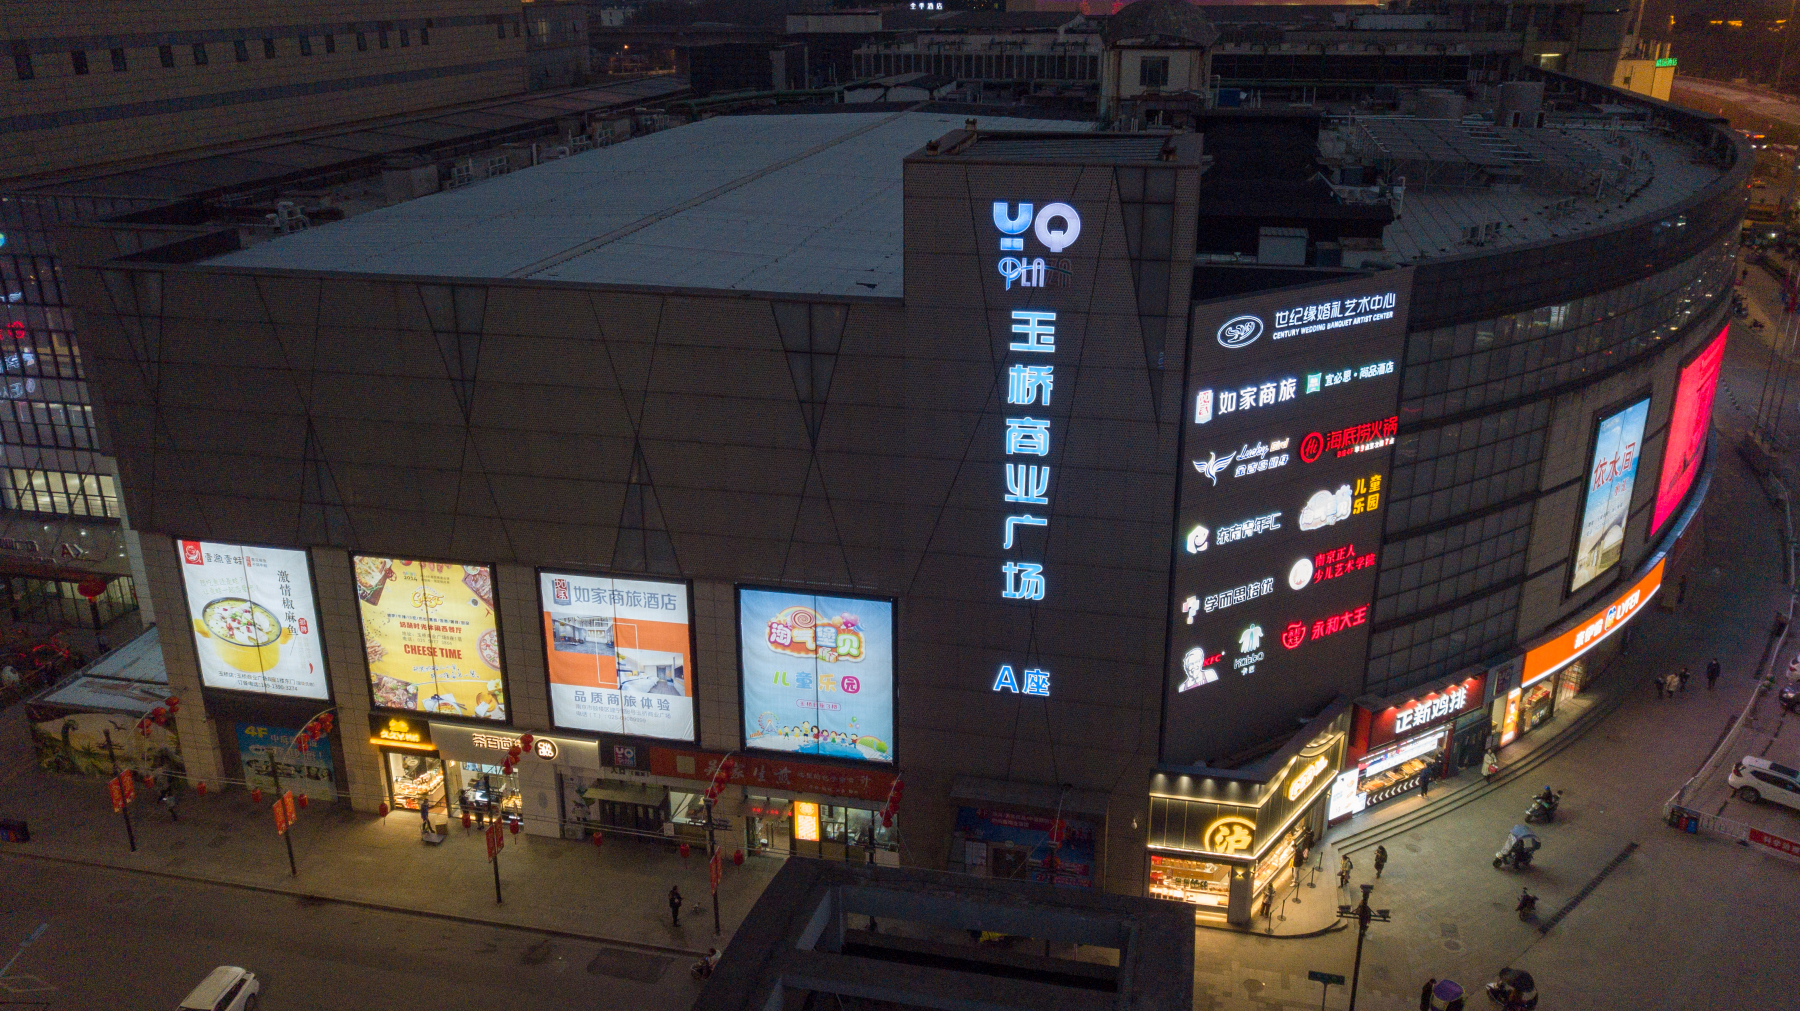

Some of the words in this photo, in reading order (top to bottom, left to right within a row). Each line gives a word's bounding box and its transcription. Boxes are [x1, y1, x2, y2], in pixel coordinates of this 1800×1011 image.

[1272, 328, 1300, 340] CENTURY
[1300, 323, 1326, 335] WEDDING
[1326, 319, 1352, 330] BANQUET
[1352, 315, 1372, 327] ARTIST
[1372, 311, 1394, 322] CENTER
[1275, 292, 1396, 328] 世纪缘婚礼艺术中心
[1218, 377, 1297, 415] 如家商旅
[1325, 416, 1398, 452] 海底捞火锅
[1002, 310, 1057, 601] 玉桥商业广场
[1592, 441, 1636, 492] 依水间
[1354, 474, 1382, 496] 儿童
[1352, 493, 1380, 515] 乐园
[1216, 512, 1282, 545] 东南青年汇
[1313, 552, 1376, 584] 少儿艺术学院
[1315, 544, 1356, 568] 南京正人
[277, 570, 298, 636] 激情椒麻鱼
[573, 585, 677, 611] 如家商旅酒店
[1204, 577, 1274, 613] 学而思培优
[399, 621, 462, 634] 奶酪时光休闲西餐厅
[1311, 605, 1367, 640] 永和大王
[403, 644, 438, 657] CHEESE
[439, 647, 462, 660] TIME
[768, 622, 860, 657] 淘气堡贝
[1202, 653, 1221, 667] KFC
[773, 670, 861, 694] 儿童乐园
[993, 665, 1050, 697] A座
[574, 690, 671, 712] 品质商旅体验
[1395, 687, 1467, 734] 正新鸡排
[244, 725, 268, 738] 4F
